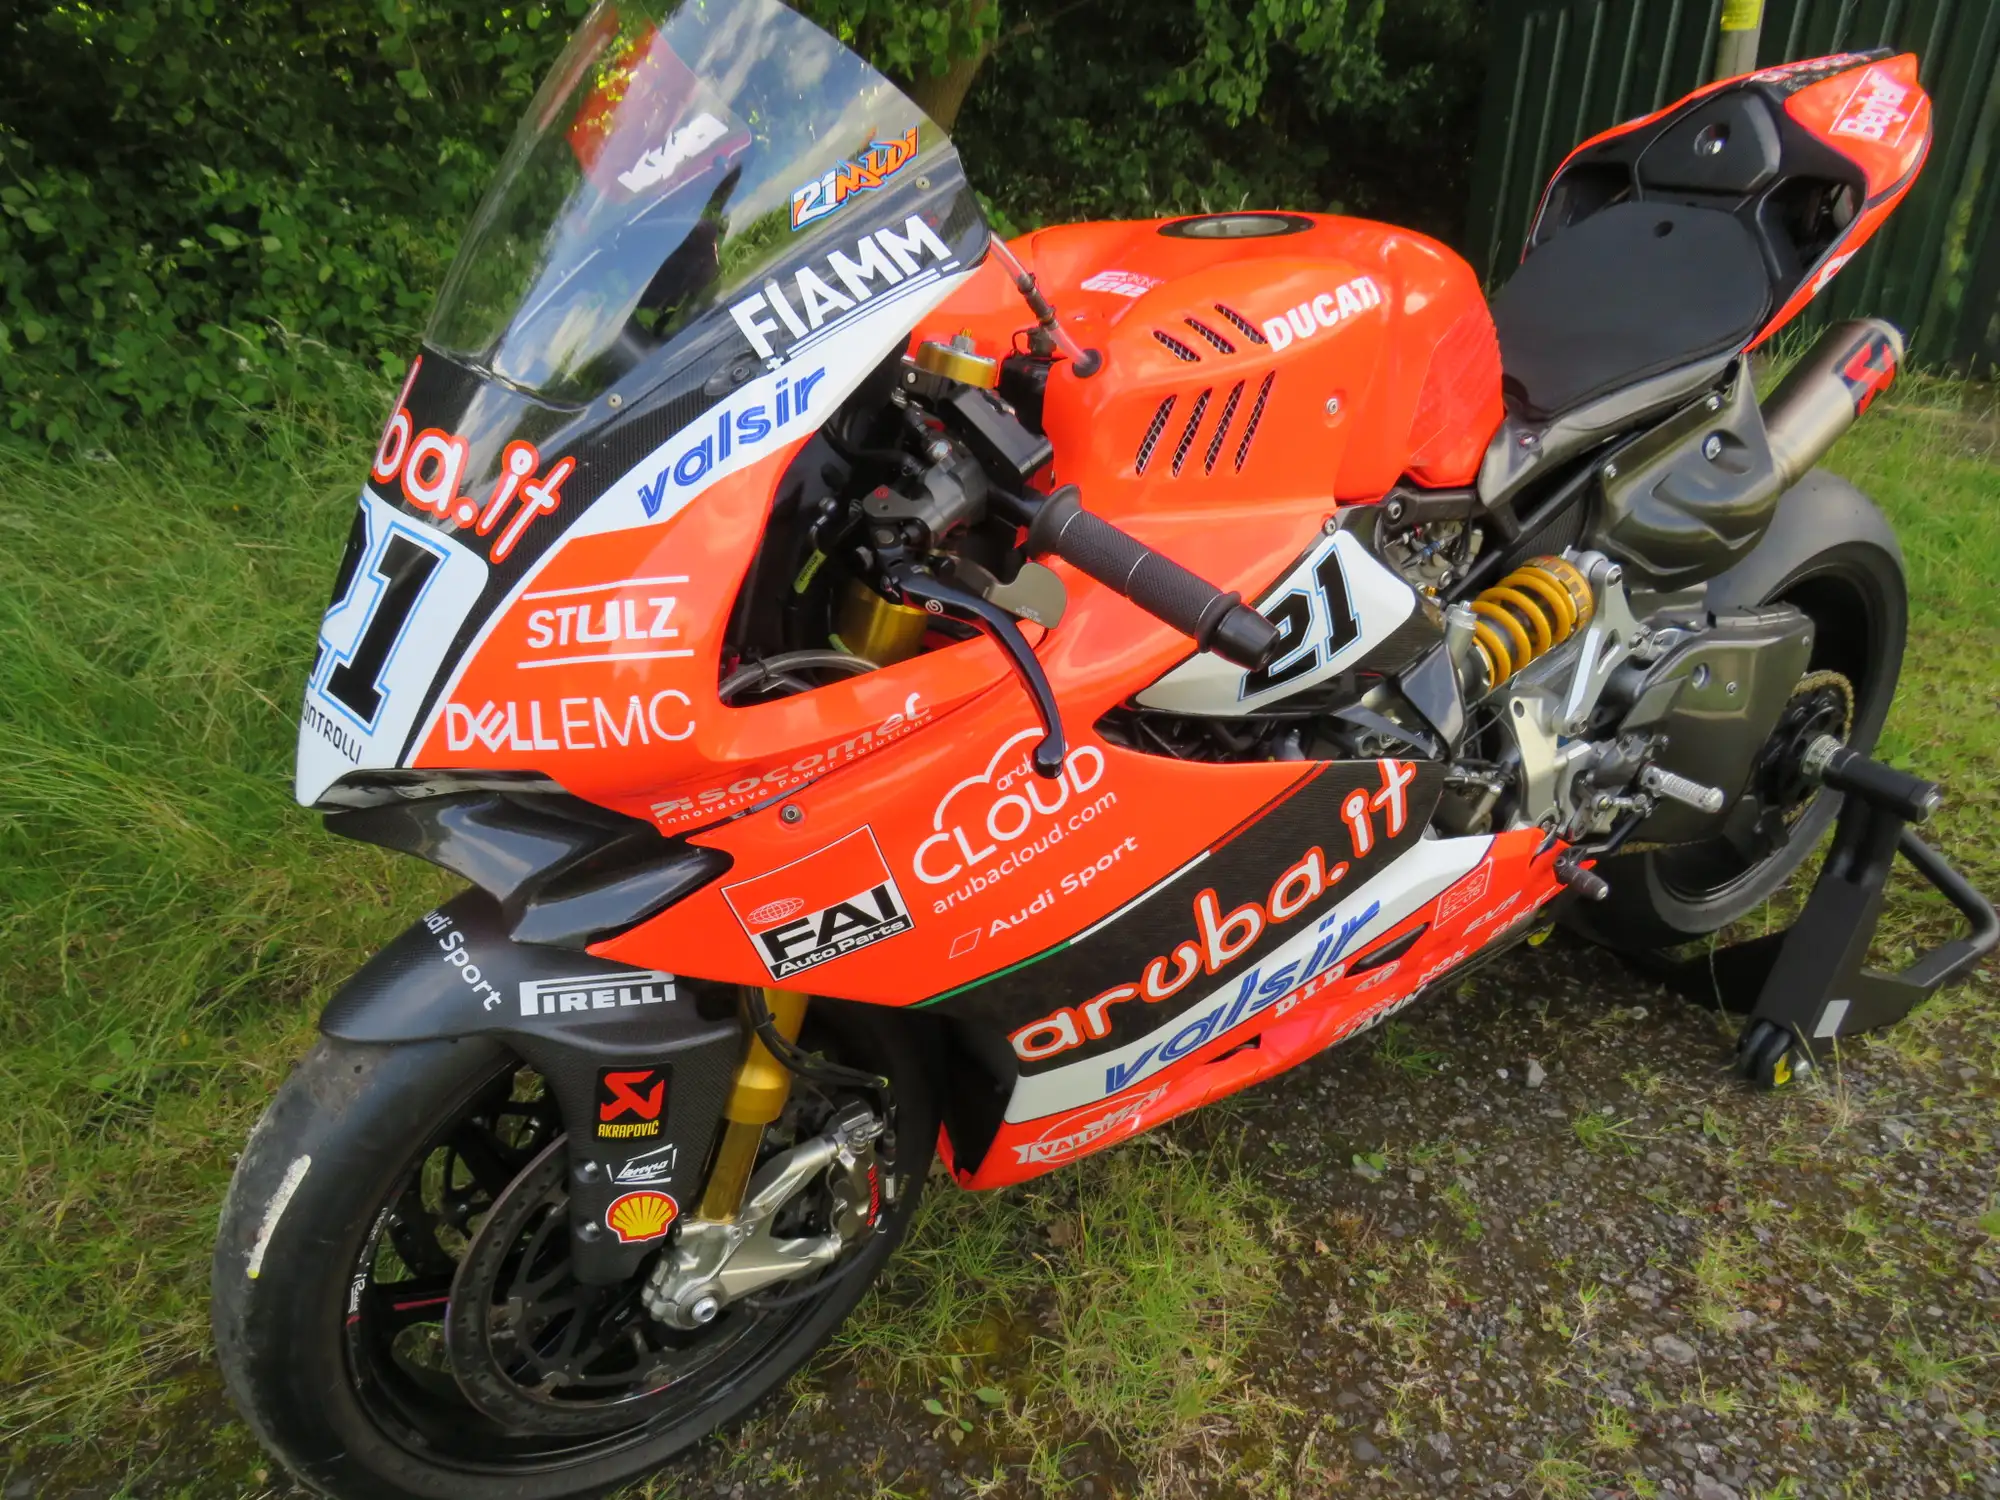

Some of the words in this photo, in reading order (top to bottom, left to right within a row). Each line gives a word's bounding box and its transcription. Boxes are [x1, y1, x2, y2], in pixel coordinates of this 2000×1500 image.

[729, 214, 953, 359] FIAMM
[1262, 276, 1381, 352] DUCATI
[637, 367, 826, 519] valsir
[527, 597, 679, 648] STULZ
[1237, 544, 1362, 702] 21
[658, 789, 769, 825] Innovative
[778, 761, 836, 789] Power
[846, 714, 934, 761] Solutions
[697, 692, 931, 805] socomec
[913, 745, 1105, 885] CLOUD
[933, 790, 1118, 914] arubacloud.com
[760, 885, 905, 963] FAI
[988, 893, 1058, 939] Audi
[1061, 835, 1139, 895] Sport
[1007, 759, 1416, 1061] aruba.it
[439, 930, 502, 1011] Sport
[519, 970, 677, 1016] PIRELLI
[778, 946, 838, 976] Auto
[840, 919, 906, 952] Parts
[1105, 900, 1380, 1094] valsir
